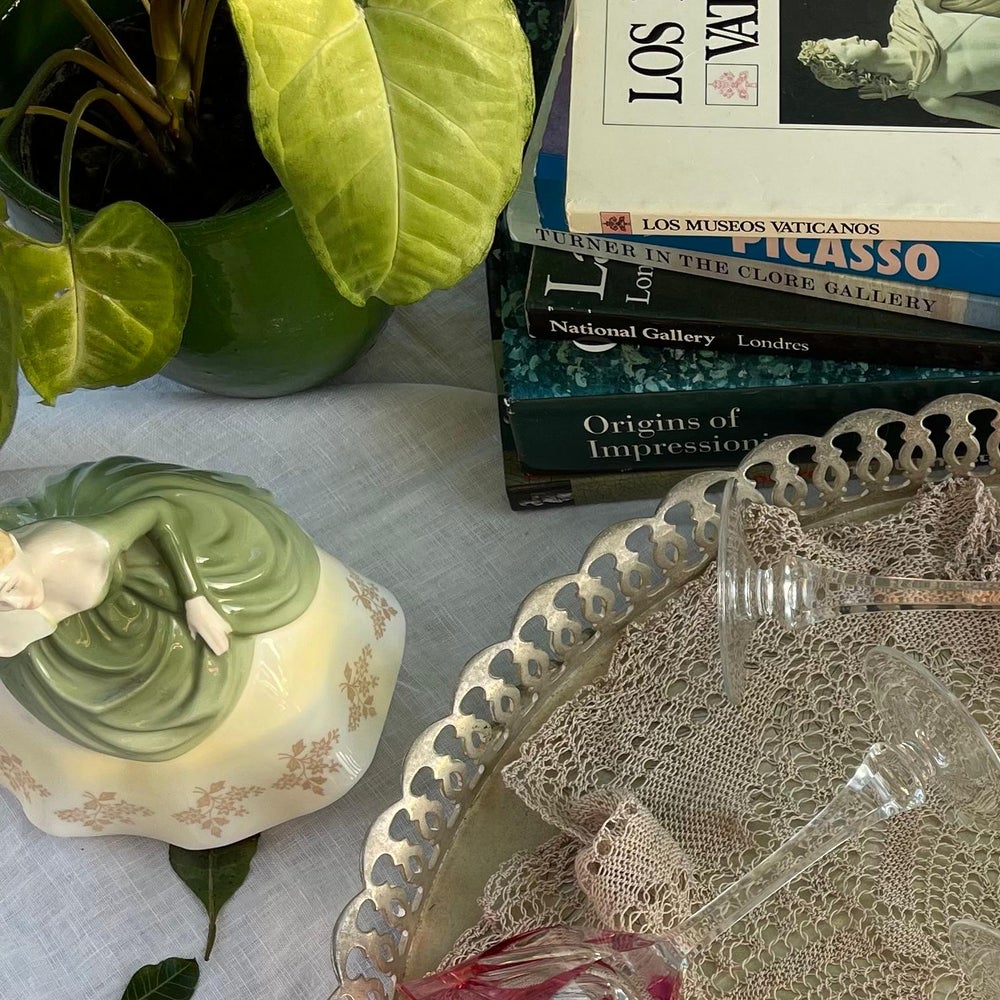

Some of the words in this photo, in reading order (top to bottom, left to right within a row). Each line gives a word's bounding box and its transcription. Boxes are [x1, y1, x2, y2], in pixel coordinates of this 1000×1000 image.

[628, 22, 685, 104] LOS
[642, 218, 681, 231] LOS
[685, 219, 766, 233] MUSEOS
[770, 220, 880, 235] VATICANOS
[536, 230, 636, 257] TURNER
[645, 248, 671, 264] IN
[679, 254, 729, 274] THE
[738, 265, 815, 291] CLORE
[824, 281, 937, 312] GALLERY
[549, 320, 637, 339] National
[641, 328, 716, 346] Gallery
[737, 334, 810, 352] Londres
[583, 413, 701, 438] Origins
[709, 407, 741, 429] of
